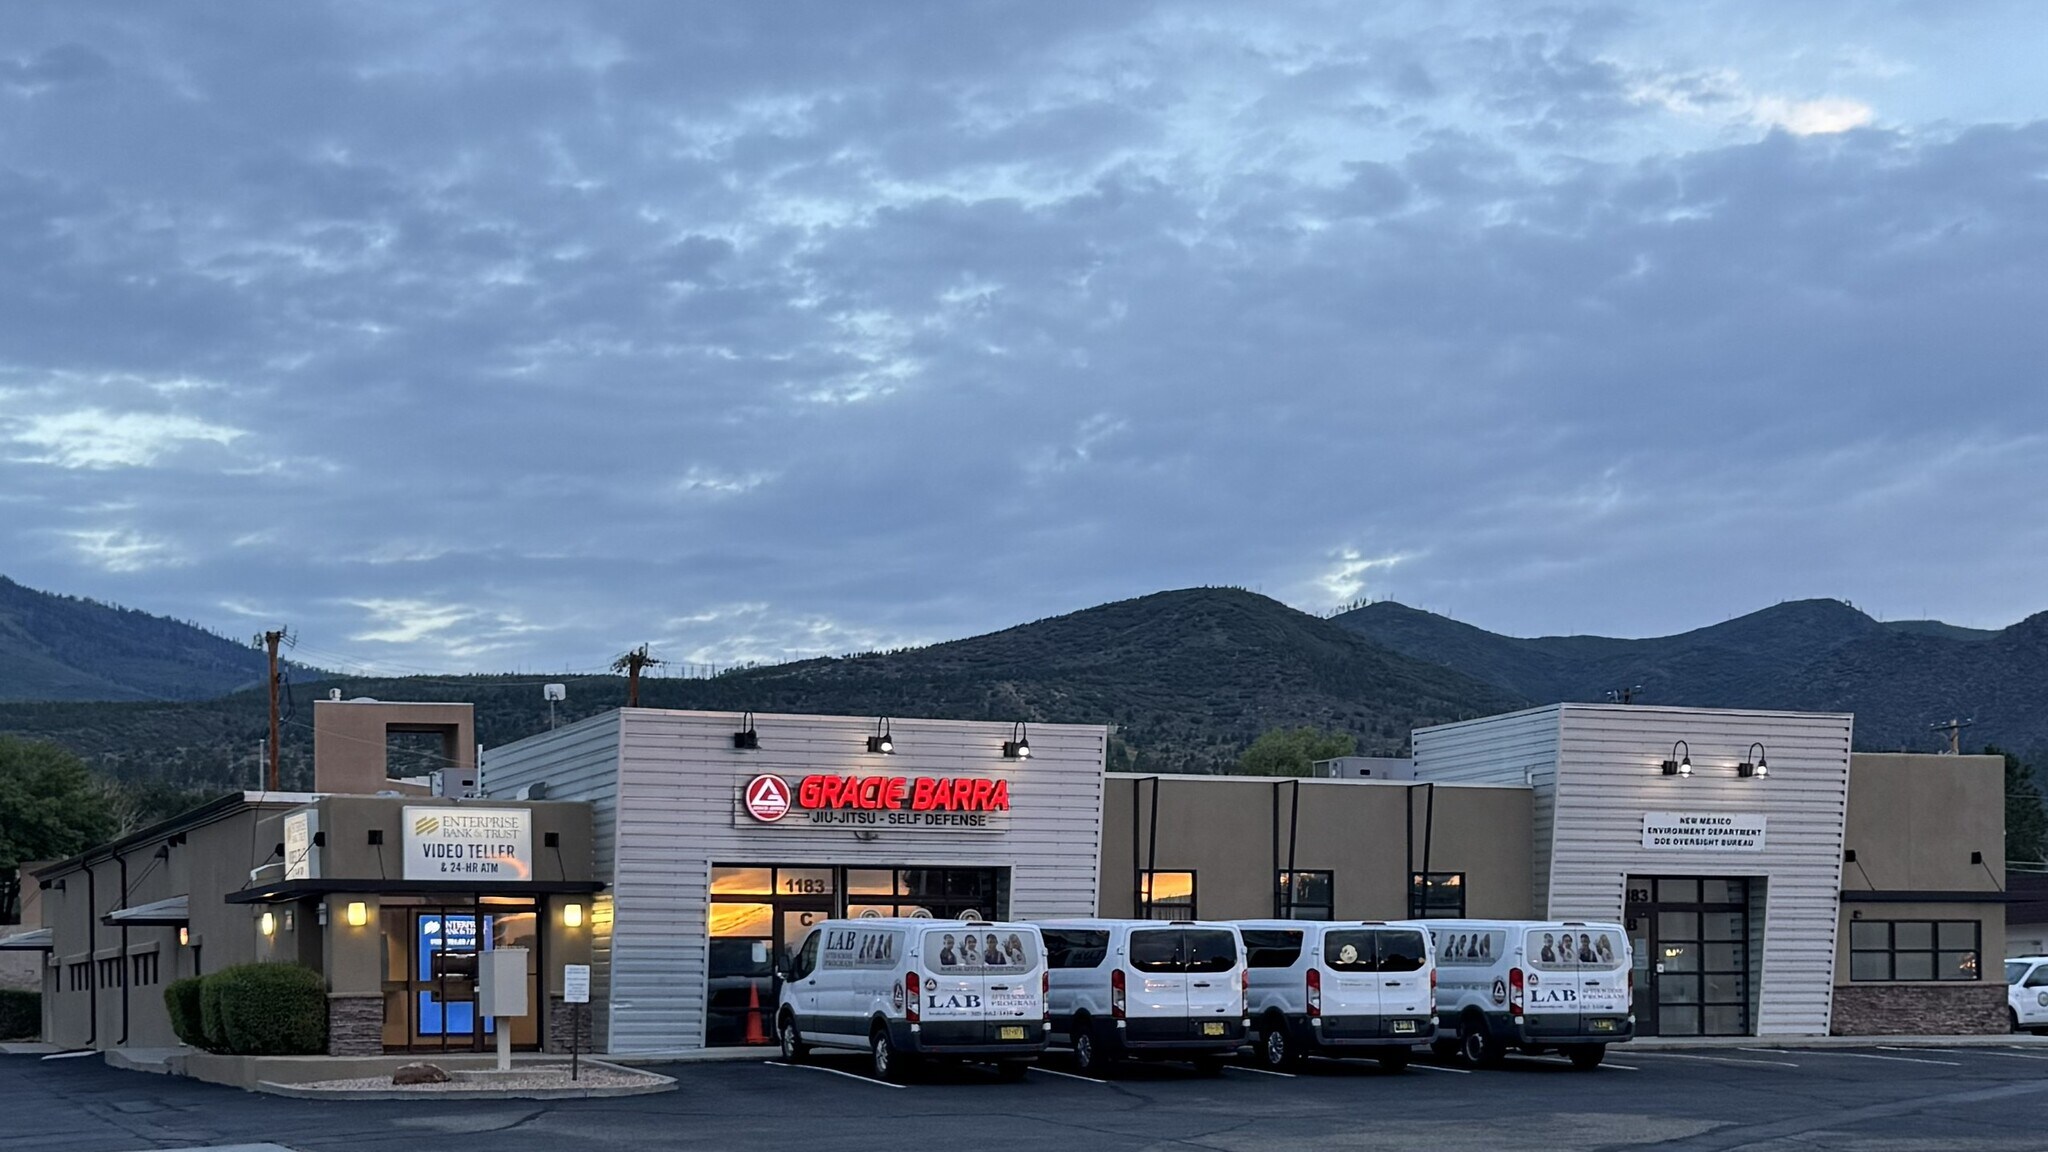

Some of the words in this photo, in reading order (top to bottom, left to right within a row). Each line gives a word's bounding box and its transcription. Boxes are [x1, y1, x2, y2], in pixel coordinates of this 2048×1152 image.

[800, 775, 907, 810] GRACIE
[911, 777, 1009, 812] BARRA
[443, 816, 520, 829] ENTERPRISE
[812, 812, 876, 824] JIU-JITSU
[888, 813, 922, 825] SELF
[925, 814, 986, 826] DEFENSE
[1699, 817, 1731, 825] MEXICO
[443, 828, 473, 838] BANK
[474, 829, 483, 838] &
[485, 829, 520, 839] TRUST
[1648, 827, 1705, 835] ENVIRONMENT
[1707, 828, 1761, 836] DEPARTMENT
[1673, 838, 1718, 846] OVERSIGHT
[423, 843, 463, 858] VIDEO
[468, 844, 515, 858] TELLER
[440, 862, 447, 872] &
[450, 862, 478, 873] 24-HR
[481, 863, 499, 873] ATM
[785, 878, 825, 893] 1183
[800, 912, 813, 927] C
[1626, 919, 1638, 931] B
[826, 931, 857, 950] LAB
[928, 995, 981, 1008] LAB
[1530, 989, 1577, 1002] LAB
